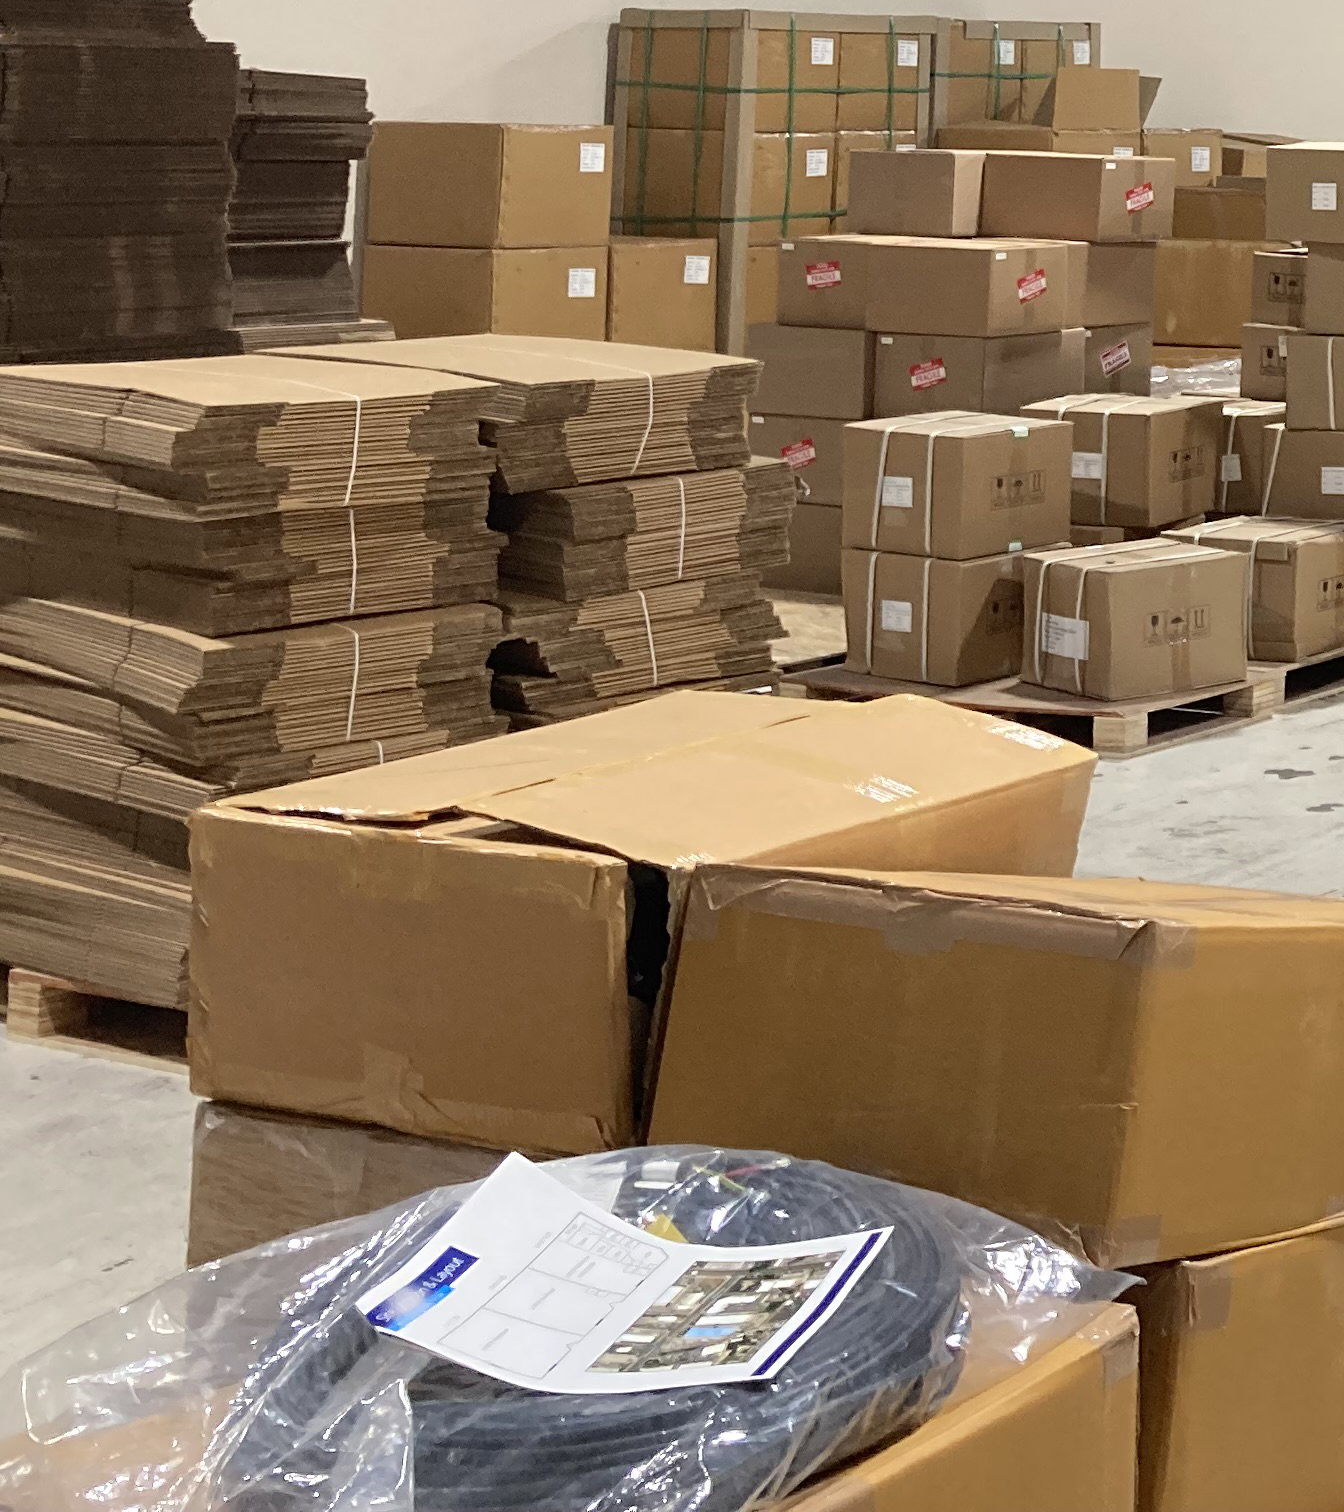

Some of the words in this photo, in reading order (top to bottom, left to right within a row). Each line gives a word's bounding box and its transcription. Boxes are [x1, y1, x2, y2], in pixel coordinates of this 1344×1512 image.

[811, 273, 836, 283] FRAGILE
[915, 369, 940, 382] FRAGILE
[431, 1257, 464, 1283] Layout
